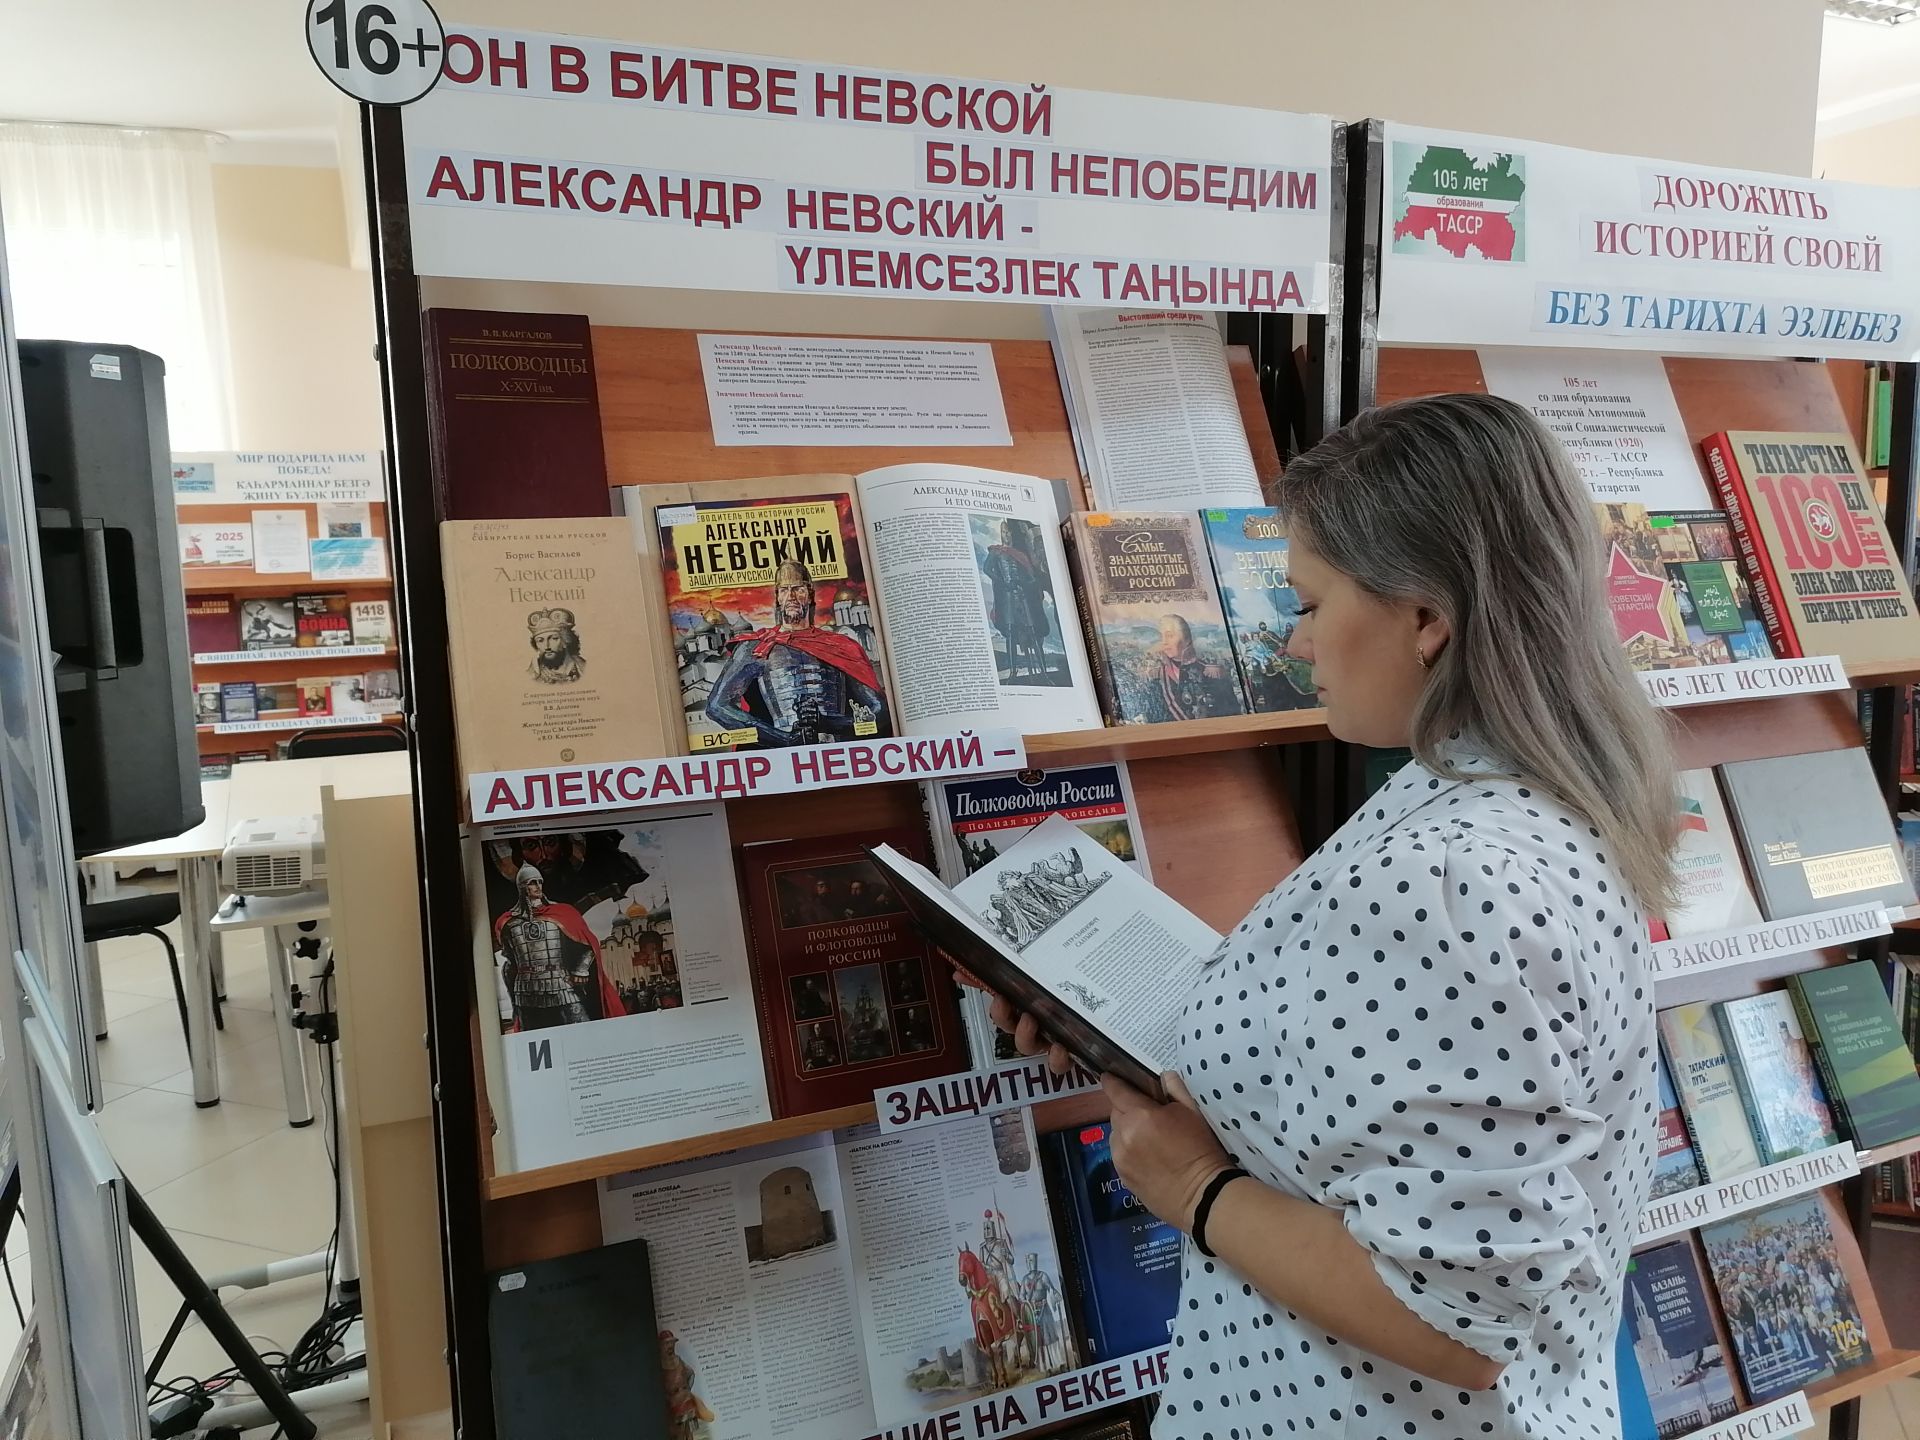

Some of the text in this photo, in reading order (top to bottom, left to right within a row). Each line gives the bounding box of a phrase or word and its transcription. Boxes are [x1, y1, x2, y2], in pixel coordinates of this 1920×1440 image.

[315, 0, 440, 75] 16+
[443, 34, 1053, 136] ОН В БИТВЕ НЕВСКОЙ
[926, 141, 1317, 212] БЫЛ НЕПОБЕДИМ
[1432, 168, 1488, 193] 105 лет
[426, 156, 762, 229] АЛЕКСАНДР
[787, 189, 1003, 241] НЕВСКИЙ
[1436, 195, 1484, 210] образования
[1653, 174, 1829, 221] ДОРОЖИТЬ
[1437, 213, 1484, 235] ТАССР
[1594, 220, 1883, 273] ИСТОРИЕЙ СВОЕЙ
[1093, 261, 1304, 312] ТАҢЫНДА
[1546, 290, 1903, 344] БЕЗ ТАРИХТА ЭЗЛЕБЕЗ
[502, 330, 552, 340] КАРГАЛОВ
[450, 353, 589, 377] ПОЛКОВОДЦЫ
[1563, 377, 1598, 388] 105 лет
[1538, 393, 1631, 404] со дня образования
[1531, 406, 1646, 419] Татарской Автономной
[1575, 422, 1666, 433] Социалистической
[1559, 437, 1644, 449] еспублики (1920)
[236, 454, 365, 464] МИР ПОДАРИЛА НАМ
[1612, 452, 1648, 462] ТАССР
[1709, 446, 1730, 482] ТЕПЕРЬ
[1744, 444, 1855, 474] ТАТАРСТАН
[278, 465, 332, 475] ПОБЕДА!
[1607, 467, 1664, 480] Республика
[913, 486, 1011, 501] АЛЕКСАНДР НЕВСКИЙ
[1588, 482, 1640, 495] Татарстан
[745, 506, 826, 519] ПО ИСТОРИИ РОССИИ
[945, 497, 1013, 512] И ЕГО СЫНОВЬЯ
[1724, 491, 1746, 532] ПРЕЖДЕ
[706, 517, 807, 542] АЛЕКСАНДР
[1256, 523, 1279, 538] 100
[1755, 475, 1869, 570] 100 ЕЛ
[215, 532, 244, 541] 2025
[1850, 512, 1891, 566] ЛЕТ
[505, 550, 581, 560] Борис Васильев
[683, 530, 837, 575] НЕВСКИЙ
[1109, 553, 1184, 566] ЗНАМЕНИТЫЕ
[1235, 551, 1289, 569] ВЕЛИК
[494, 567, 596, 582] Александр
[1109, 564, 1189, 579] ПОЛКОВОДЦЫ
[1748, 556, 1760, 575] 100
[688, 564, 839, 587] ЗАЩИТНИК РУССКОЙ ЗЕМЛИ
[1129, 577, 1176, 589] РОССИИ
[1791, 571, 1828, 595] ЭЛЕК
[509, 586, 585, 603] Невский
[356, 605, 385, 616] 1418
[1801, 601, 1855, 624] ПРЕЖДЕ
[1862, 598, 1908, 618] ТЕПЕРЬ
[299, 617, 348, 631] ВОЙНА
[1649, 663, 1837, 700] 105 ЛЕТ ИСТОРИИ
[247, 722, 262, 730] ОТ
[264, 719, 310, 729] СОЛДАТА
[312, 718, 328, 727] ДО
[329, 715, 378, 726] МАРШАЛА
[703, 732, 731, 747] БИС
[486, 756, 771, 814] АЛЕКСАНДР
[793, 730, 984, 784] НЕВСКИЙ
[956, 781, 1115, 816] Полководцы России
[968, 819, 1017, 832] Полная
[808, 919, 891, 944] ПОЛКОВОДЦЫ
[1668, 909, 1881, 969] ЗАКОН РЕСПУБЛИКИ
[805, 931, 897, 955] И ФЛОТОВОДЦЫ
[828, 948, 882, 966] РОССИИ
[1688, 1054, 1726, 1074] ТАТАРСКИЙ
[1691, 1073, 1709, 1087] ПУТЬ:
[1717, 1152, 1849, 1209] РЕСПУБЛИКА
[1651, 1275, 1687, 1293] КАЗАНЬ:
[1659, 1306, 1692, 1323] КУЛЬТУРА
[973, 1395, 1028, 1438] НА
[1035, 1365, 1126, 1419] РЕКЕ
